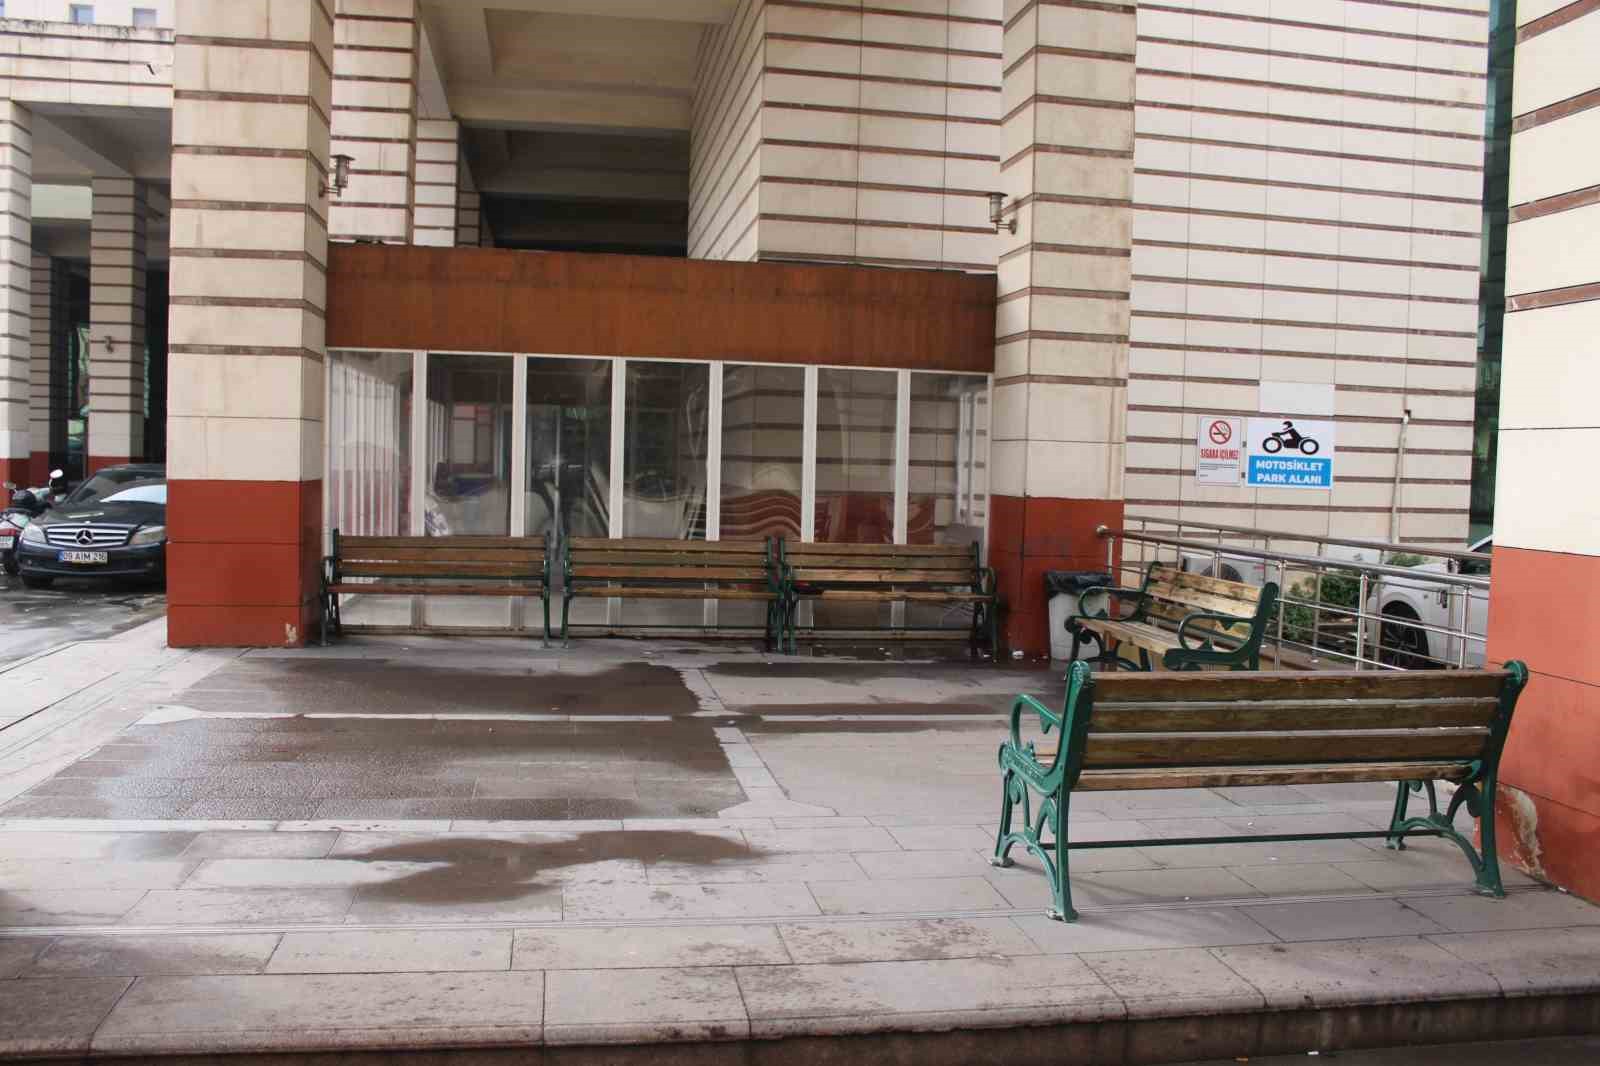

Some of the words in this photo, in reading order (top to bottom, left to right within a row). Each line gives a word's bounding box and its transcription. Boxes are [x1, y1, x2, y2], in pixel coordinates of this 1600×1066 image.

[1256, 459, 1324, 471] MOTOSİKLET
[1257, 473, 1286, 483] PARK
[1287, 474, 1322, 484] ALANI
